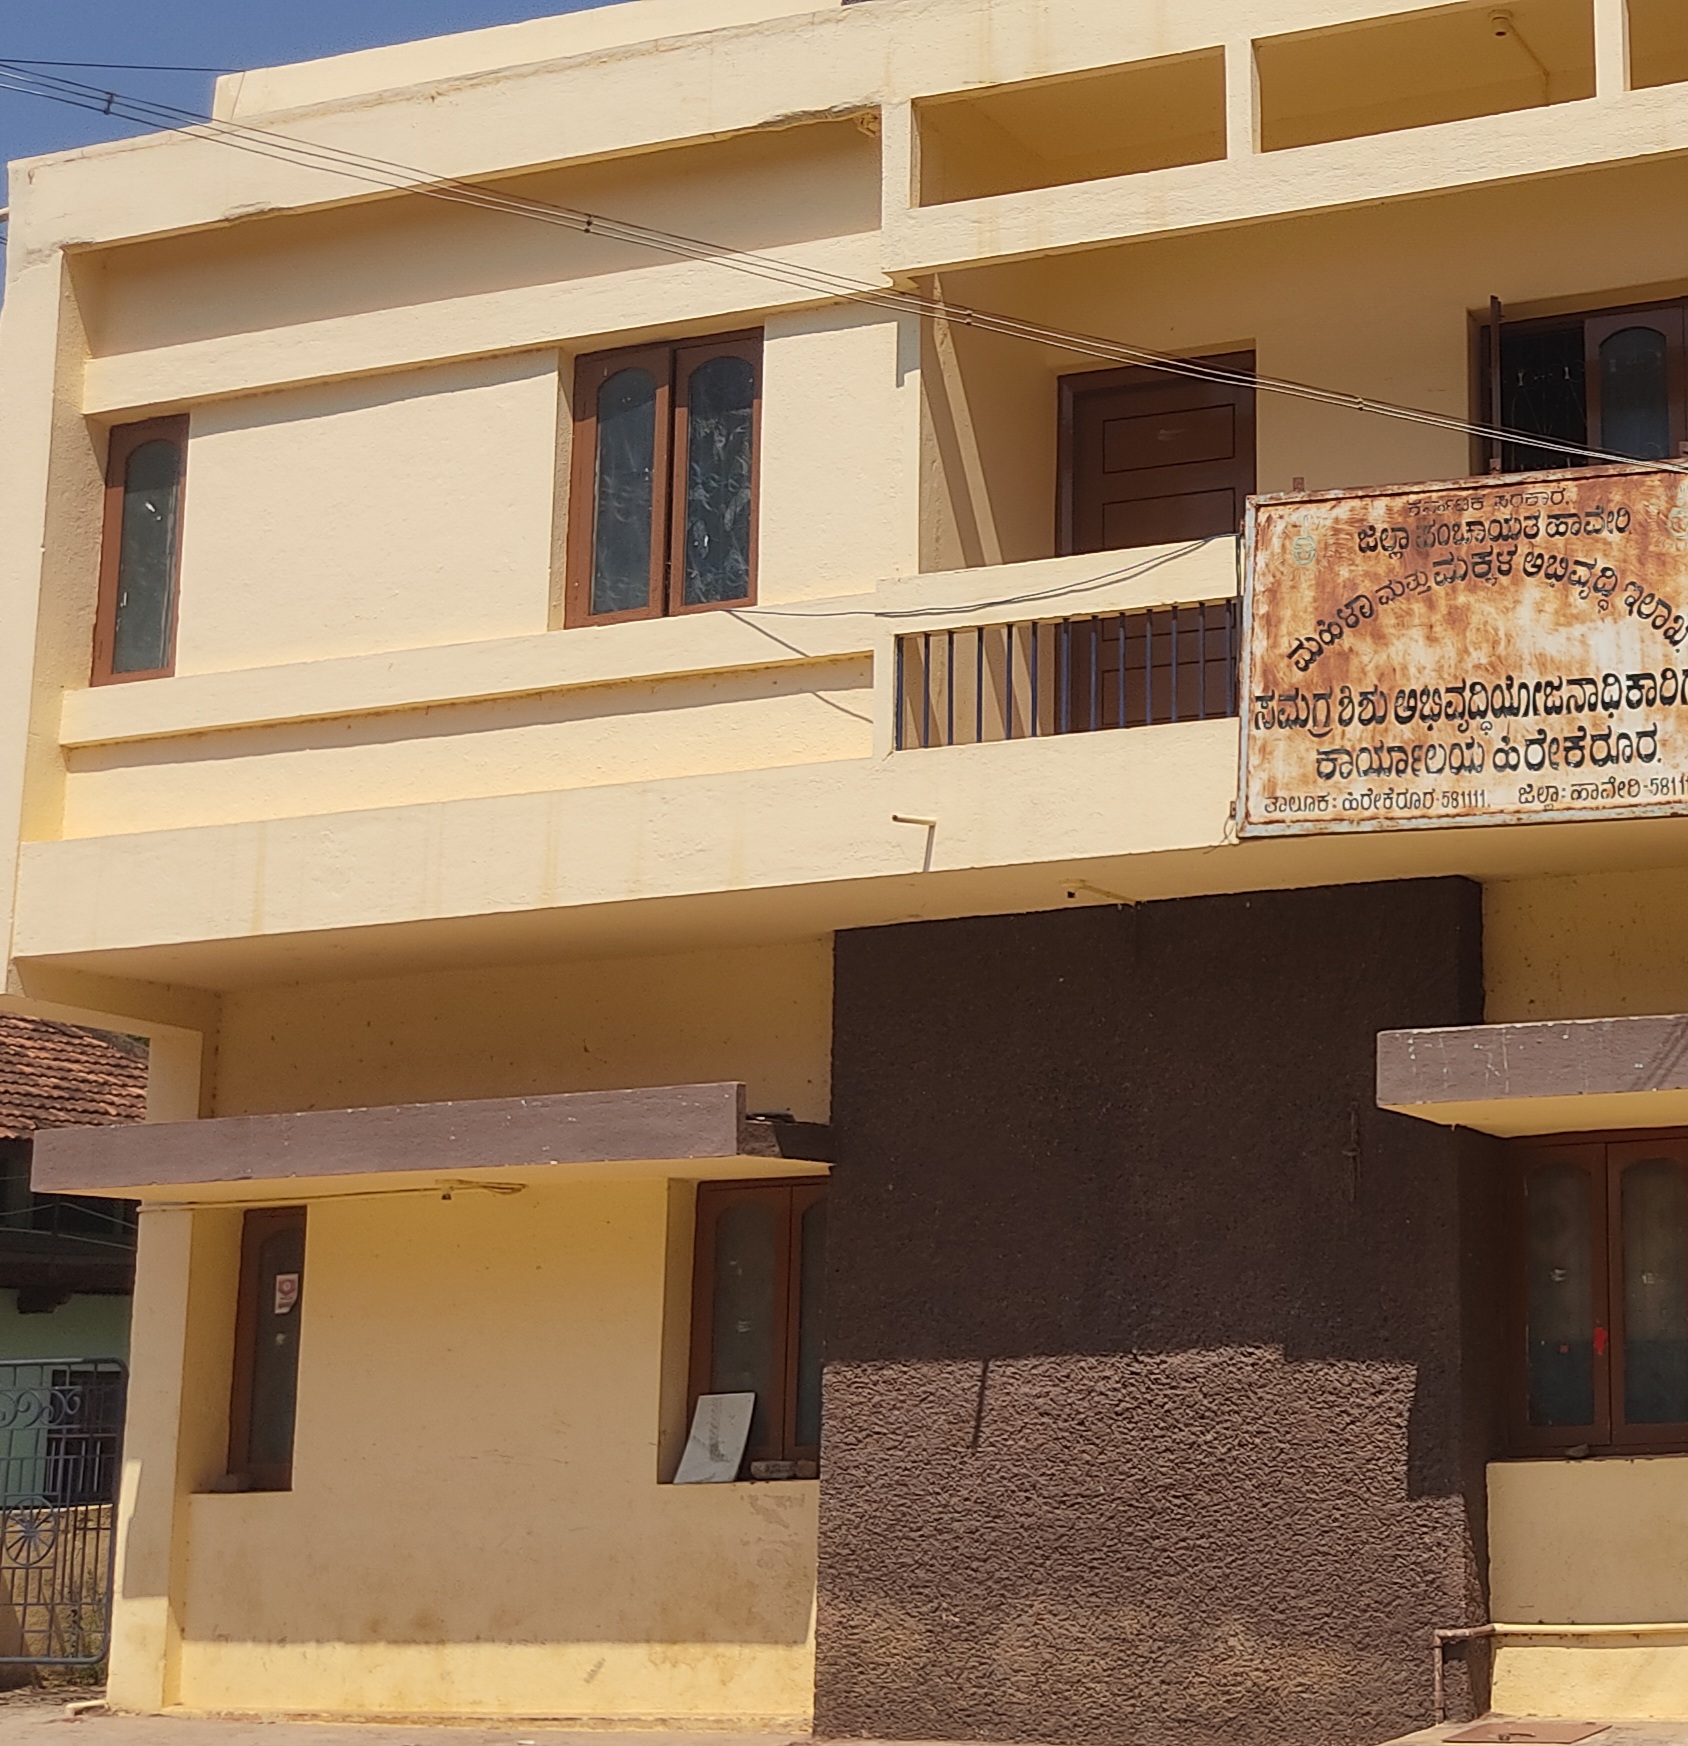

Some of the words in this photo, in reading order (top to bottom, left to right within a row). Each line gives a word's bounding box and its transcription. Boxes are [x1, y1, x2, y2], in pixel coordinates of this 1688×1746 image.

[1357, 524, 1410, 560] ಜಿಲ್ಲಾ
[1415, 510, 1540, 549] ಪಂಚಾಯತ
[1546, 504, 1631, 538] ಹಾವೇರಿ
[1286, 594, 1374, 672] ಮಹಿಳಾ
[1375, 570, 1432, 605] ಮತ್ತು
[1433, 544, 1518, 586] ಮಕ್ಕಳ
[1254, 686, 1334, 738] ಸಮಗ್ರ
[1337, 683, 1388, 727] ಶಿಶು
[1316, 735, 1486, 781] ಕಾರ್ಯಾಲಯ
